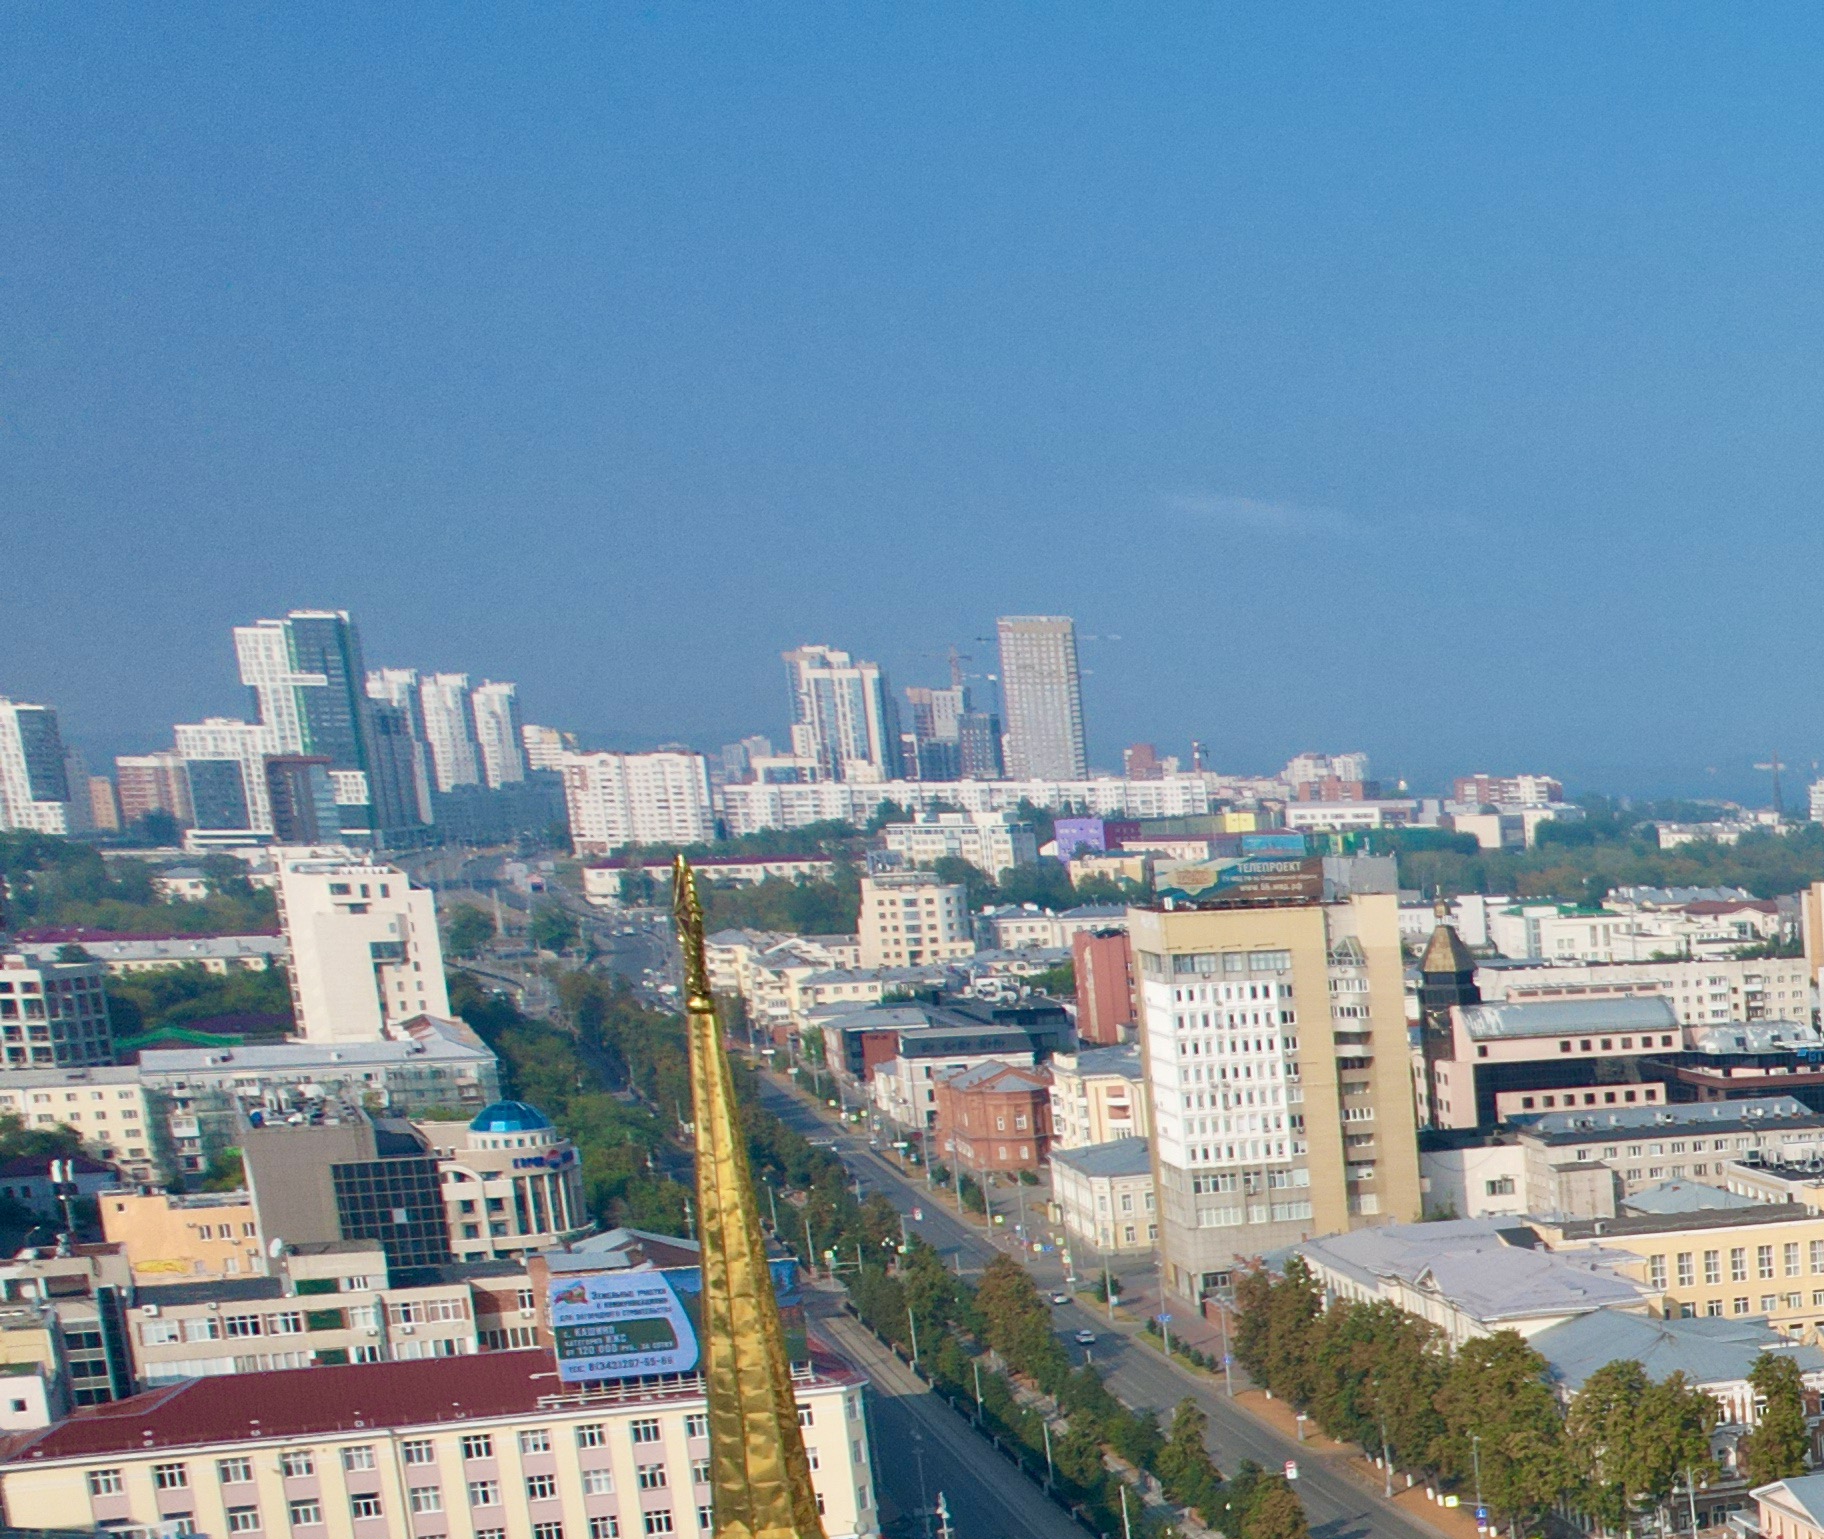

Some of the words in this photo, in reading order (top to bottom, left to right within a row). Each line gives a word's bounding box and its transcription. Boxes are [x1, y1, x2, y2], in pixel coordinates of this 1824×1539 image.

[1237, 861, 1301, 873] ТЕЛЕПРОЕКТ
[577, 1346, 595, 1355] 120
[598, 1344, 618, 1354] 000
